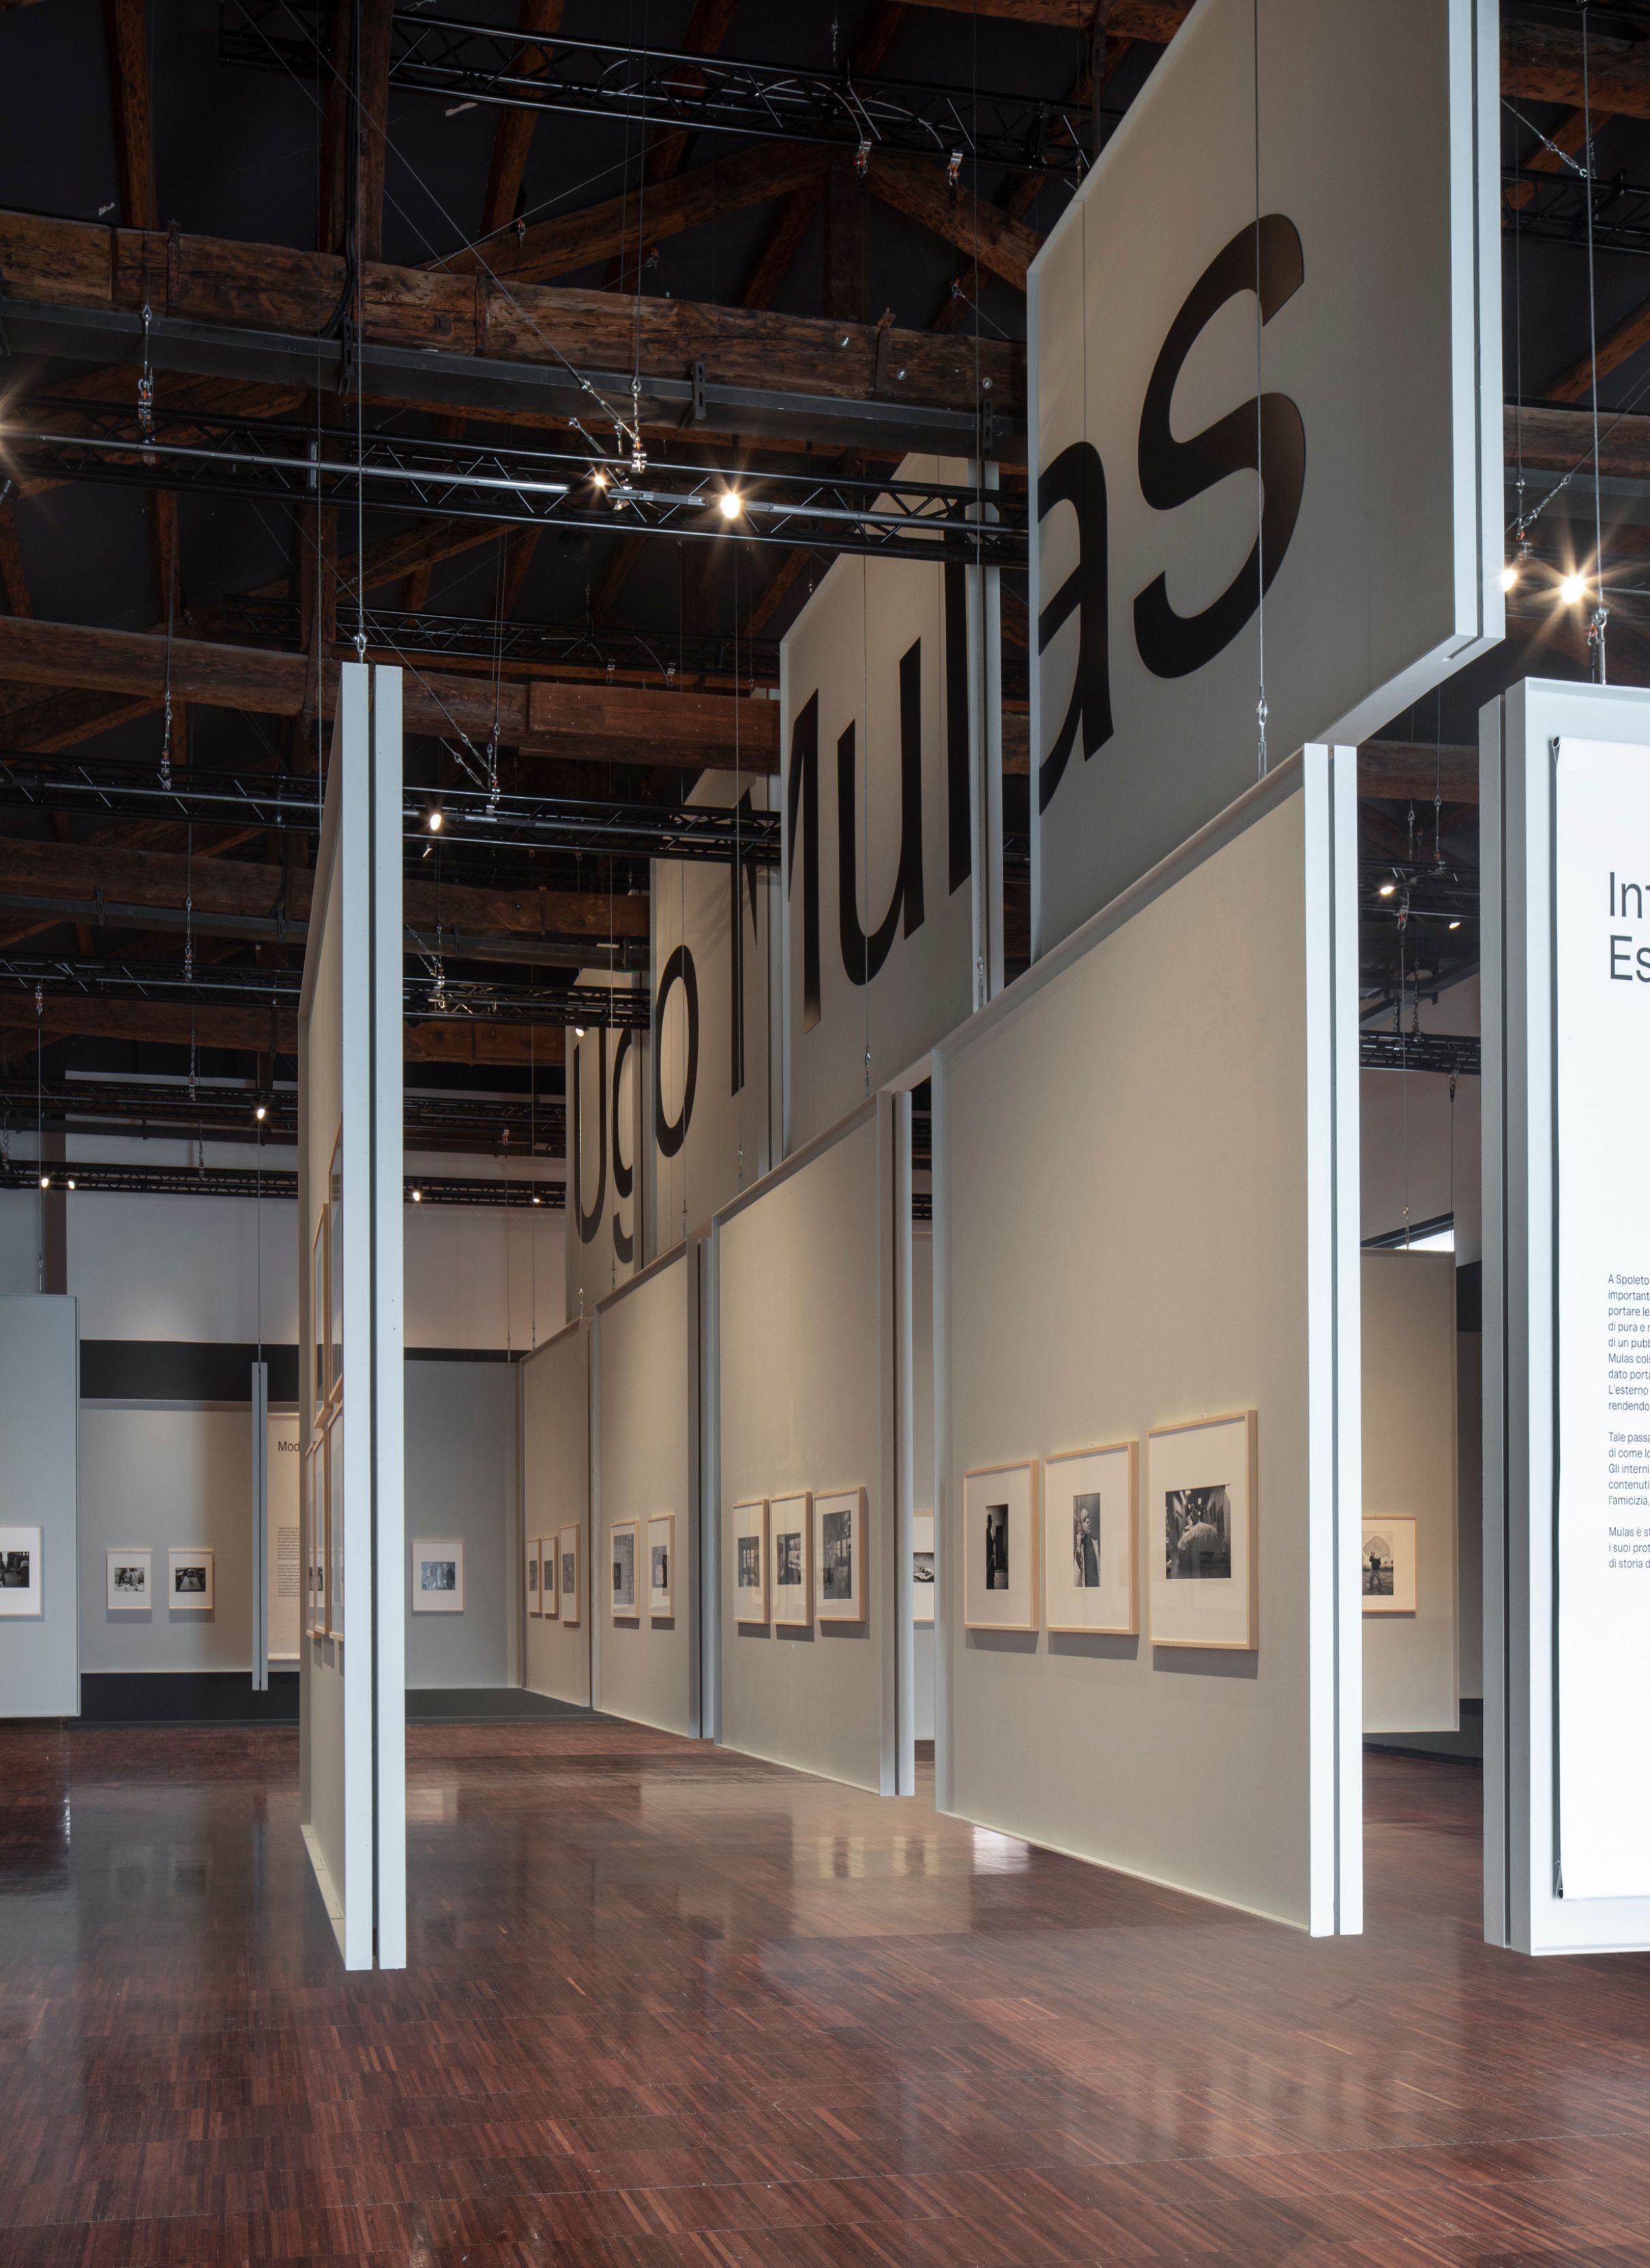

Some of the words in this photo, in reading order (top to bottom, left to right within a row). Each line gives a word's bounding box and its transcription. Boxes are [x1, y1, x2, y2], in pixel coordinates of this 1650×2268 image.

[1610, 871, 1650, 919] In
[1608, 1274, 1614, 1283] A
[1616, 1274, 1649, 1286] Spoleto
[1608, 1289, 1650, 1302] important
[1608, 1307, 1640, 1317] portare
[1608, 1322, 1615, 1331] di
[1618, 1324, 1638, 1333] pura
[1640, 1324, 1645, 1332] e
[1608, 1337, 1615, 1347] di
[1618, 1339, 1629, 1347] un
[1608, 1353, 1634, 1363] Mulas
[1608, 1369, 1627, 1379] dato
[1608, 1401, 1650, 1411] rendendo
[1608, 1432, 1625, 1442] Tale
[1608, 1448, 1616, 1458] di
[1618, 1450, 1642, 1458] come
[1608, 1463, 1619, 1474] Gli
[1621, 1464, 1650, 1474] interni
[1608, 1480, 1650, 1489] contenuti
[1608, 1527, 1634, 1537] Mulas
[1612, 1542, 1631, 1553] suoi
[1608, 1558, 1617, 1568] di
[1619, 1558, 1643, 1568] storia
